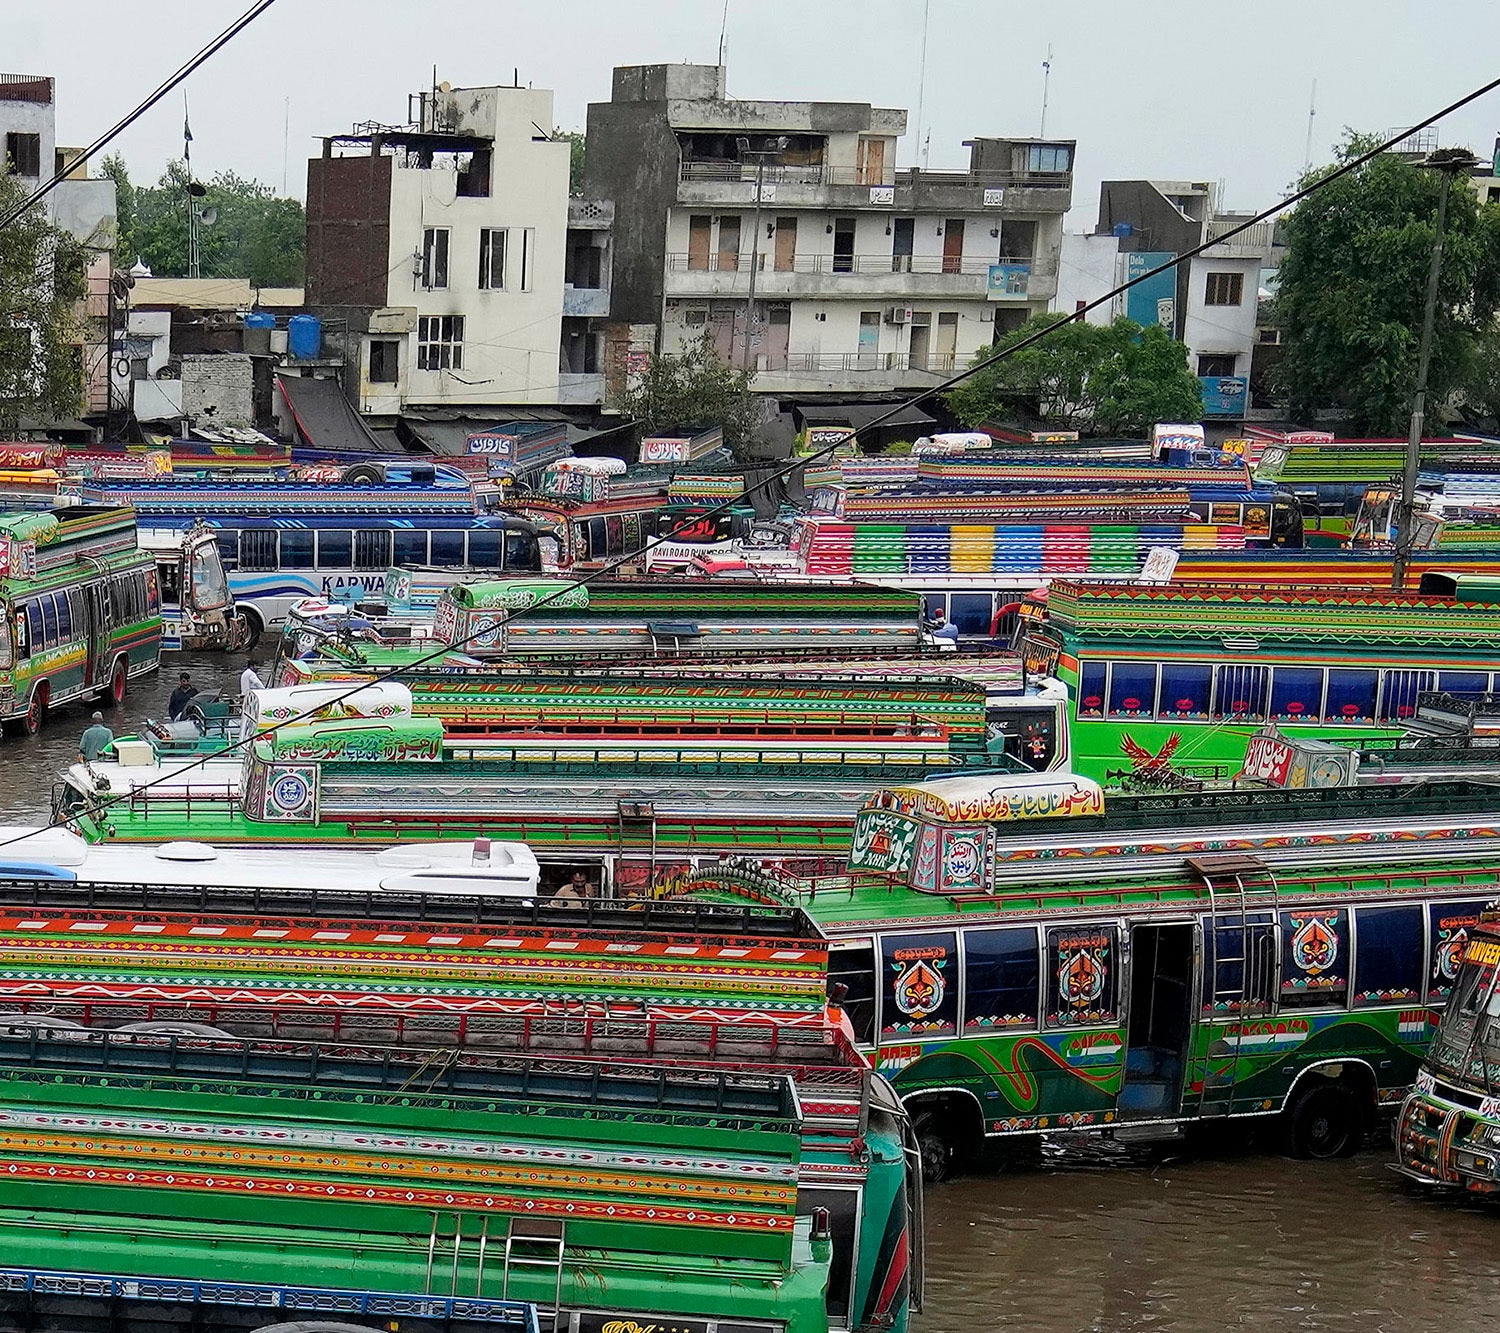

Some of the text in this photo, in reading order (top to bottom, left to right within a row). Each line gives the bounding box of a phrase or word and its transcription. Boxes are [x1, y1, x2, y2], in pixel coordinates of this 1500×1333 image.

[471, 439, 510, 454] کاروان
[648, 442, 681, 460] کاروان
[653, 548, 690, 557] RAVI ROAD
[322, 576, 385, 592] KARWA
[1059, 789, 1100, 815] لاہور
[985, 830, 994, 892] SAEED
